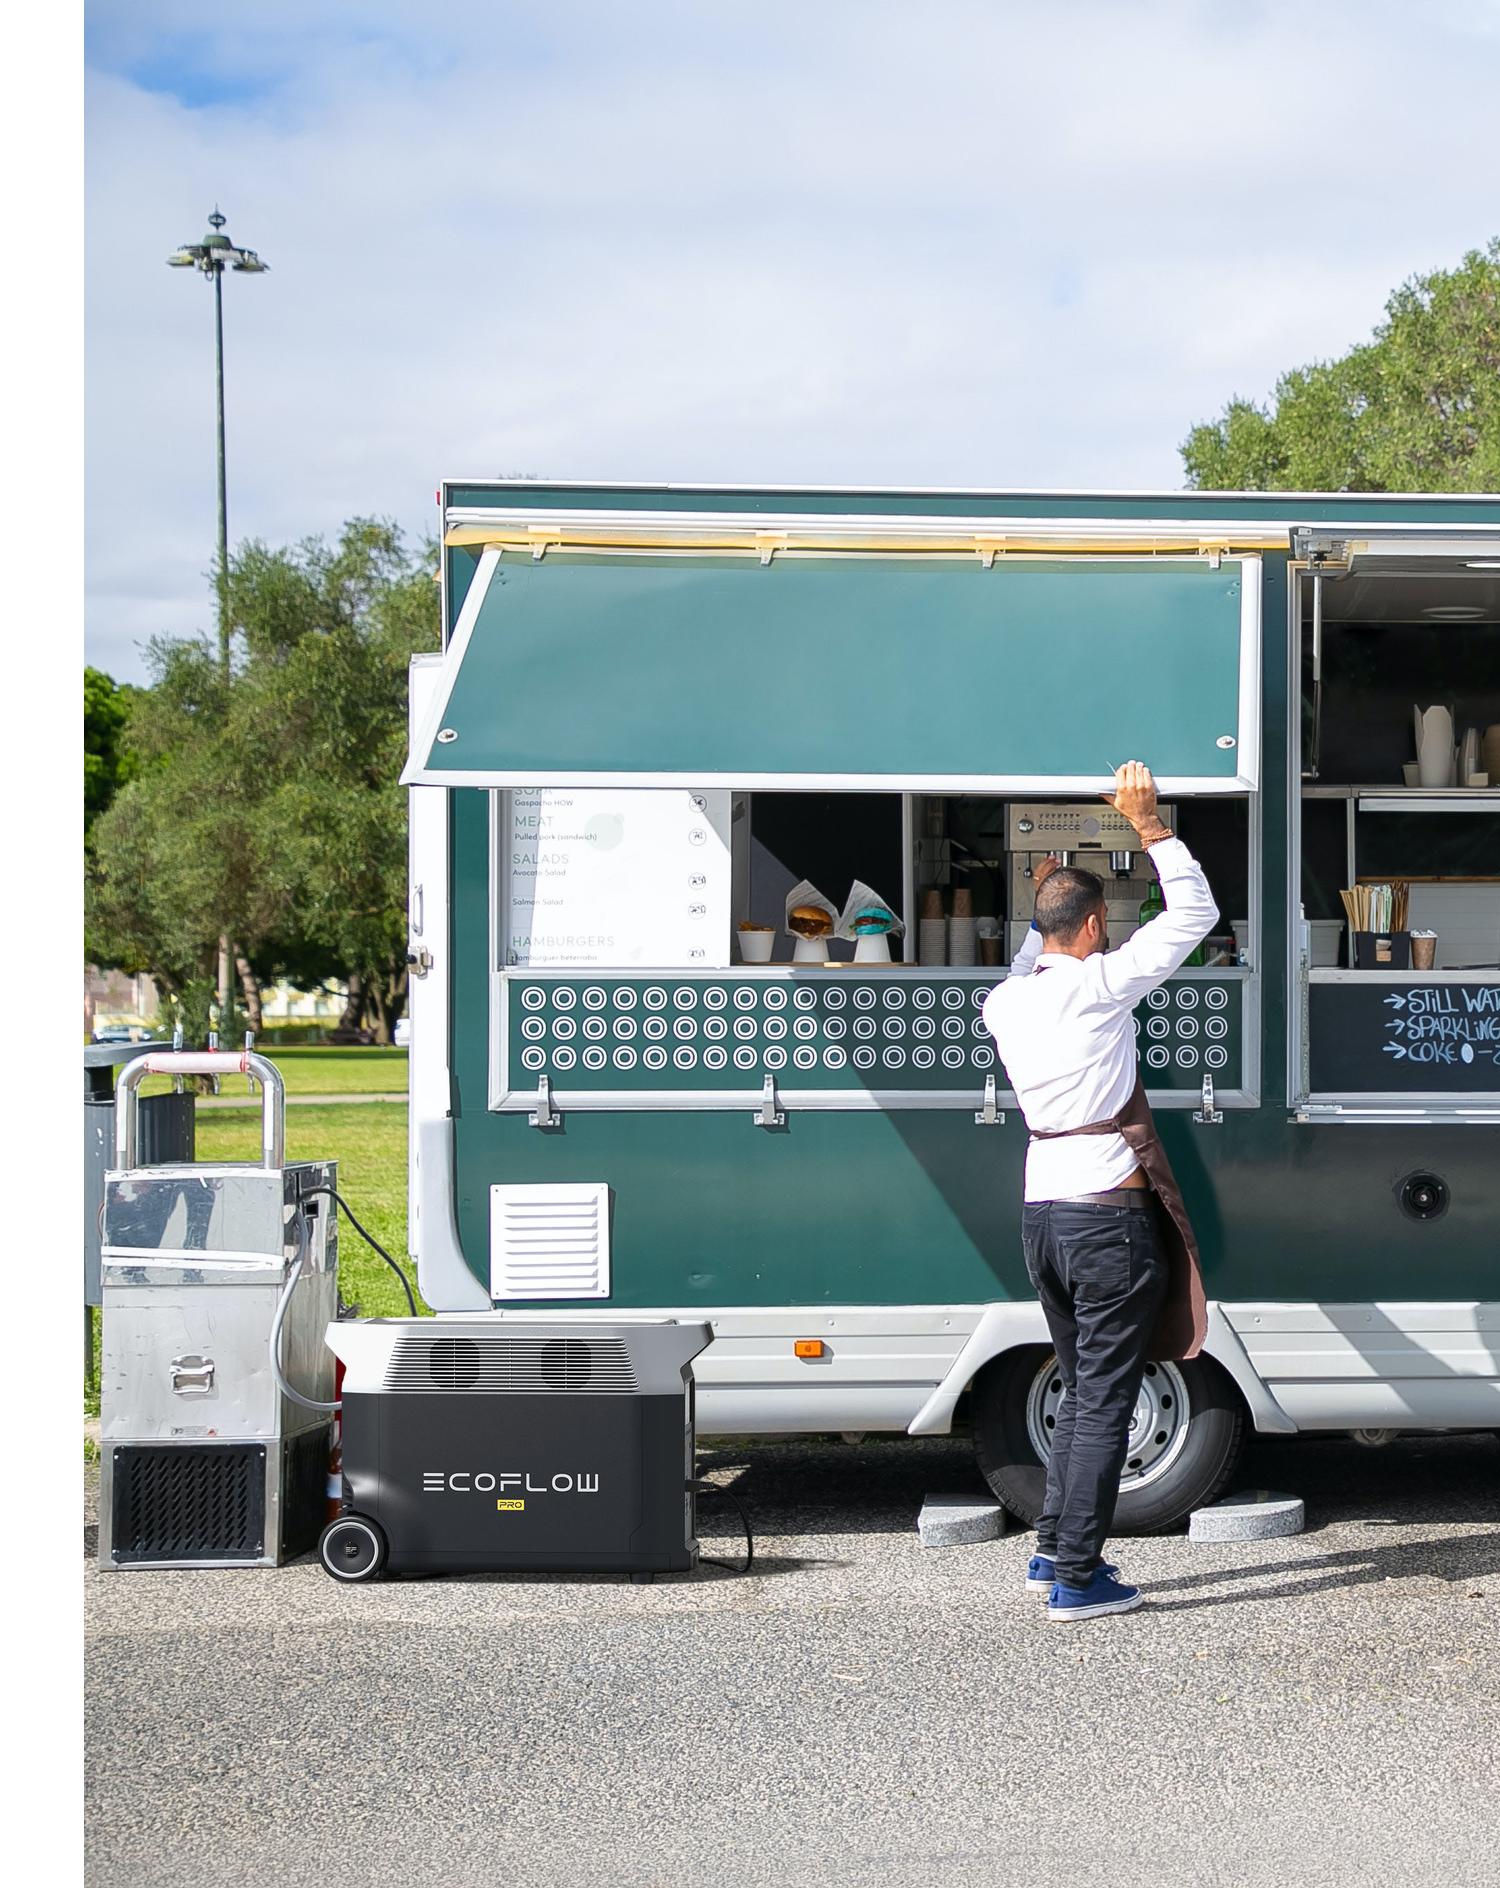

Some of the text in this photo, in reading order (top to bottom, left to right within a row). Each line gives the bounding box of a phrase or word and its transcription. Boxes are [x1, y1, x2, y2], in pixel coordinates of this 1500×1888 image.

[515, 815, 554, 827] MEAT
[514, 832, 538, 841] Pulled
[512, 853, 569, 865] SALADS
[544, 868, 567, 877] Salad
[512, 897, 564, 906] Salmon Salad
[512, 935, 615, 947] HAMBURGERS
[1407, 1040, 1459, 1065] COKE
[422, 1471, 600, 1493] ECOFLOW
[499, 1500, 523, 1510] PRO
